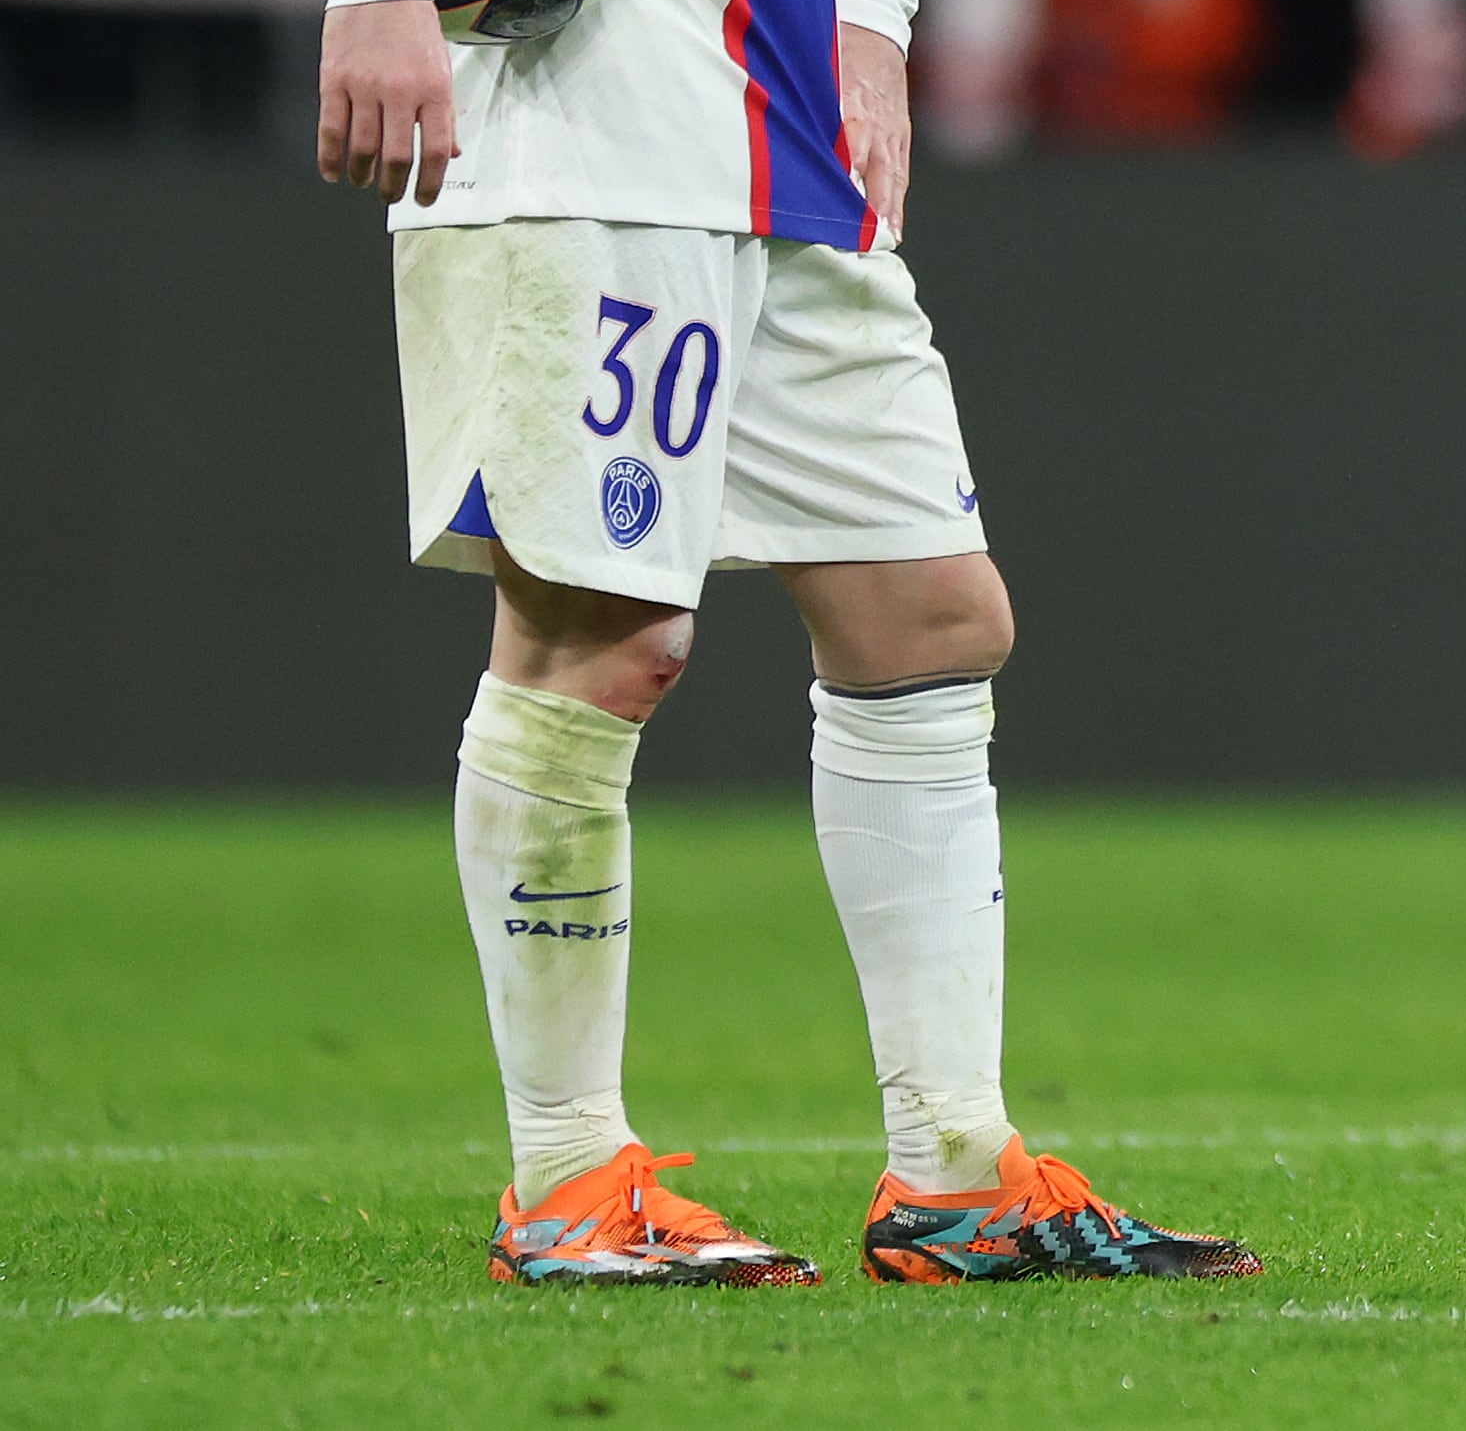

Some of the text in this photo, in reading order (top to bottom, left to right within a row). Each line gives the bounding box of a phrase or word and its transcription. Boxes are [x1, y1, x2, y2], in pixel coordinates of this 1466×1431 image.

[579, 291, 721, 461] 30
[608, 464, 651, 490] PARIS
[504, 918, 628, 940] PARIS
